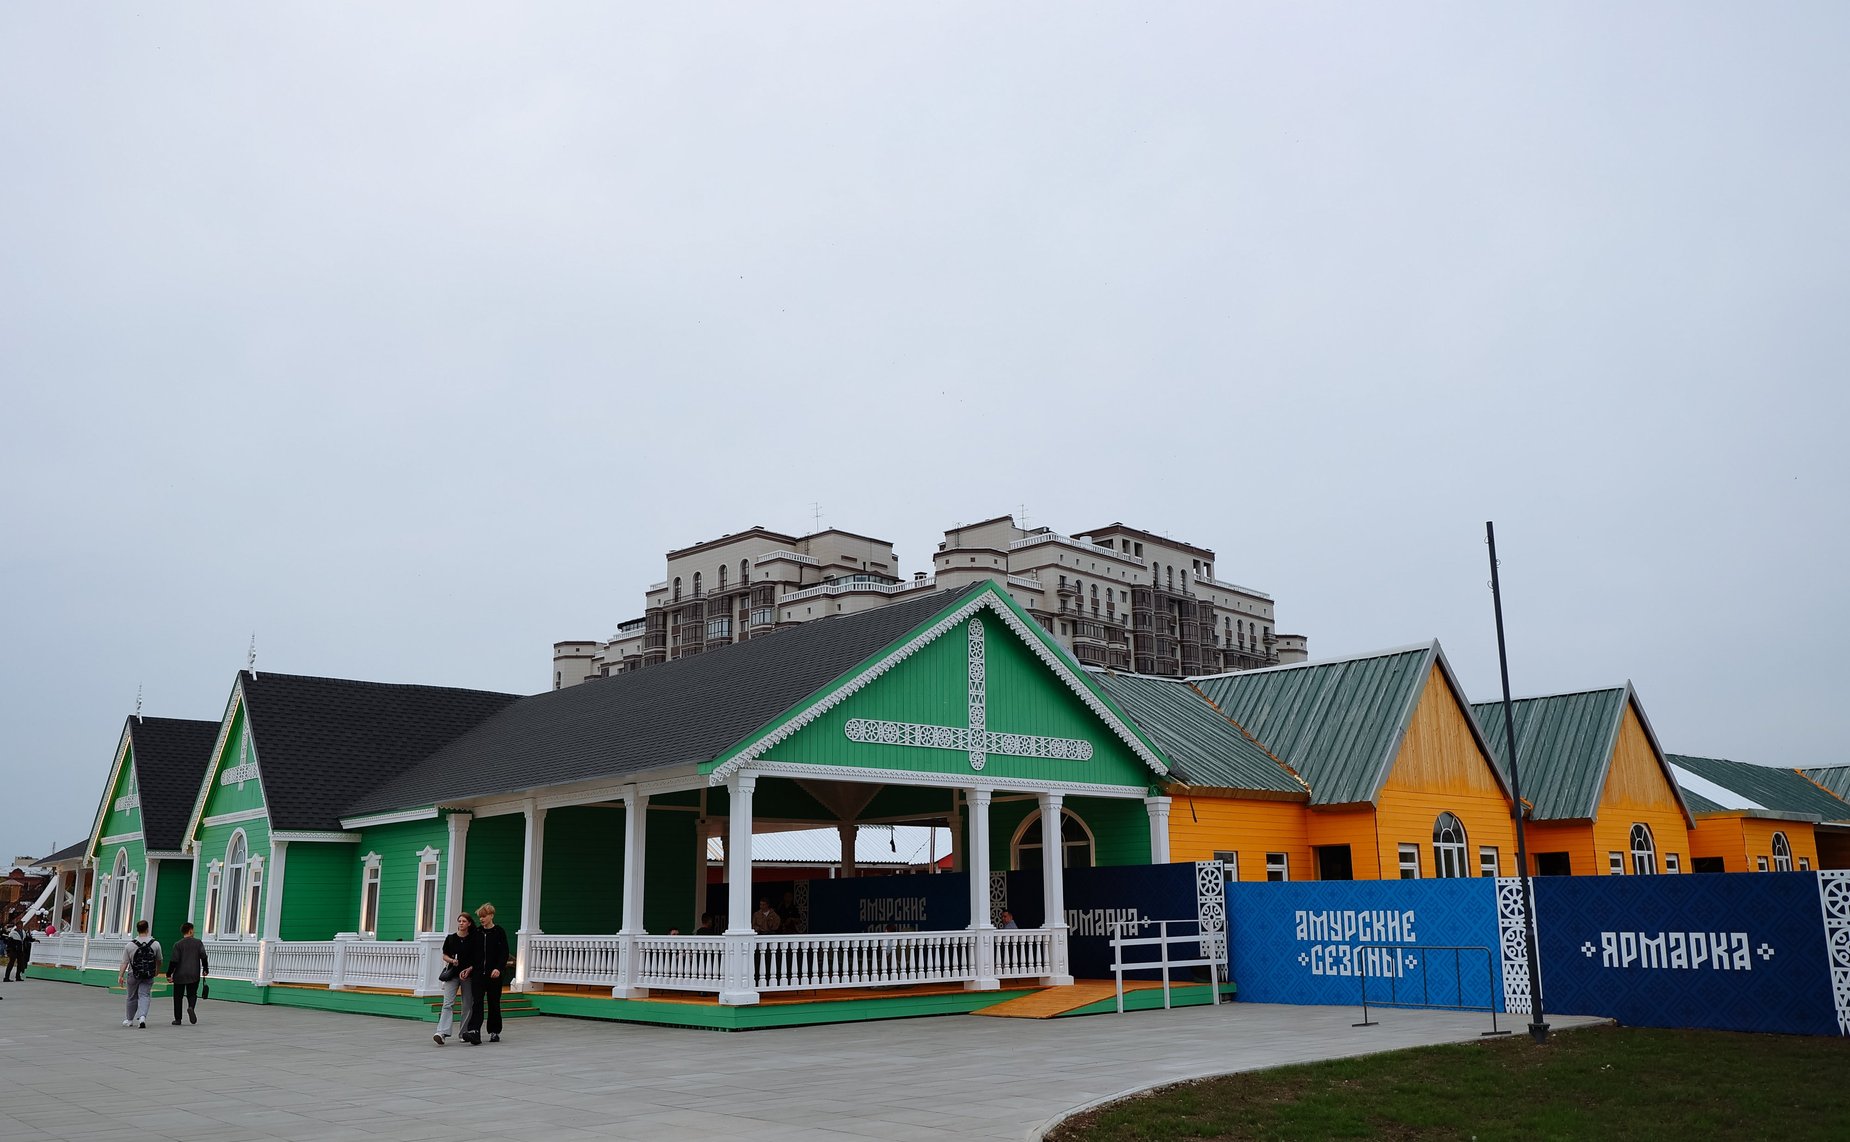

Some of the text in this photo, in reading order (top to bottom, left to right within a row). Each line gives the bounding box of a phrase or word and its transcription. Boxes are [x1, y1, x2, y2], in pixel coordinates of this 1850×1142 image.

[859, 896, 927, 921] АМУРСКИЕ
[1064, 908, 1139, 936] РМАРКА
[1295, 910, 1416, 942] АМУРСКИЕ
[1310, 944, 1403, 978] СЕЗОНЫ
[1600, 932, 1752, 970] ЯРМАРКА
